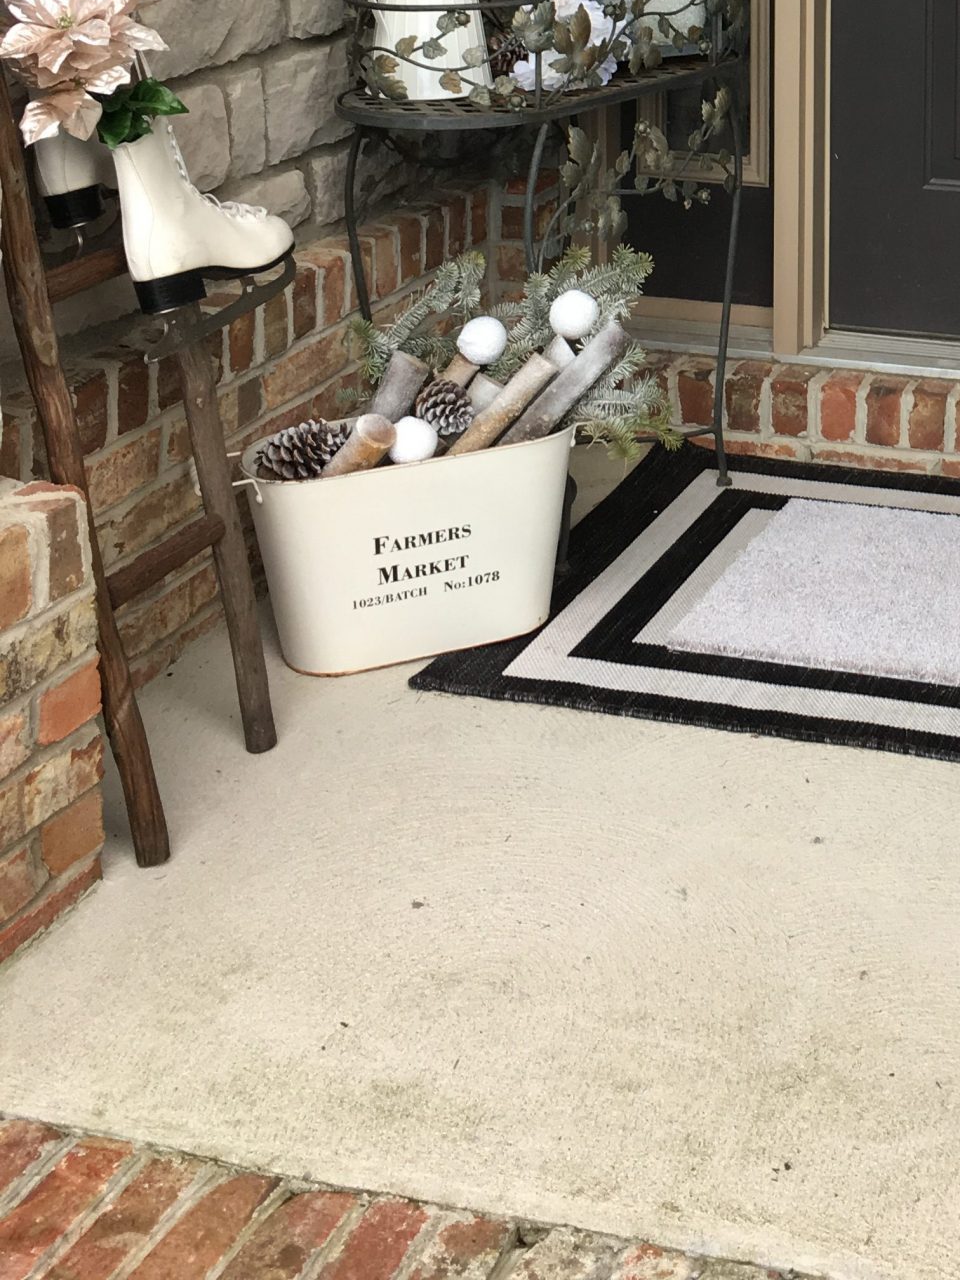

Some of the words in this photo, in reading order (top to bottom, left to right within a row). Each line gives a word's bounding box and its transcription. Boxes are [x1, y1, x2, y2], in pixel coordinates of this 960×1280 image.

[373, 524, 472, 556] FARMERS
[377, 555, 470, 585] MARKET
[352, 587, 428, 609] 1023/BATCH
[444, 571, 500, 592] No:1078
